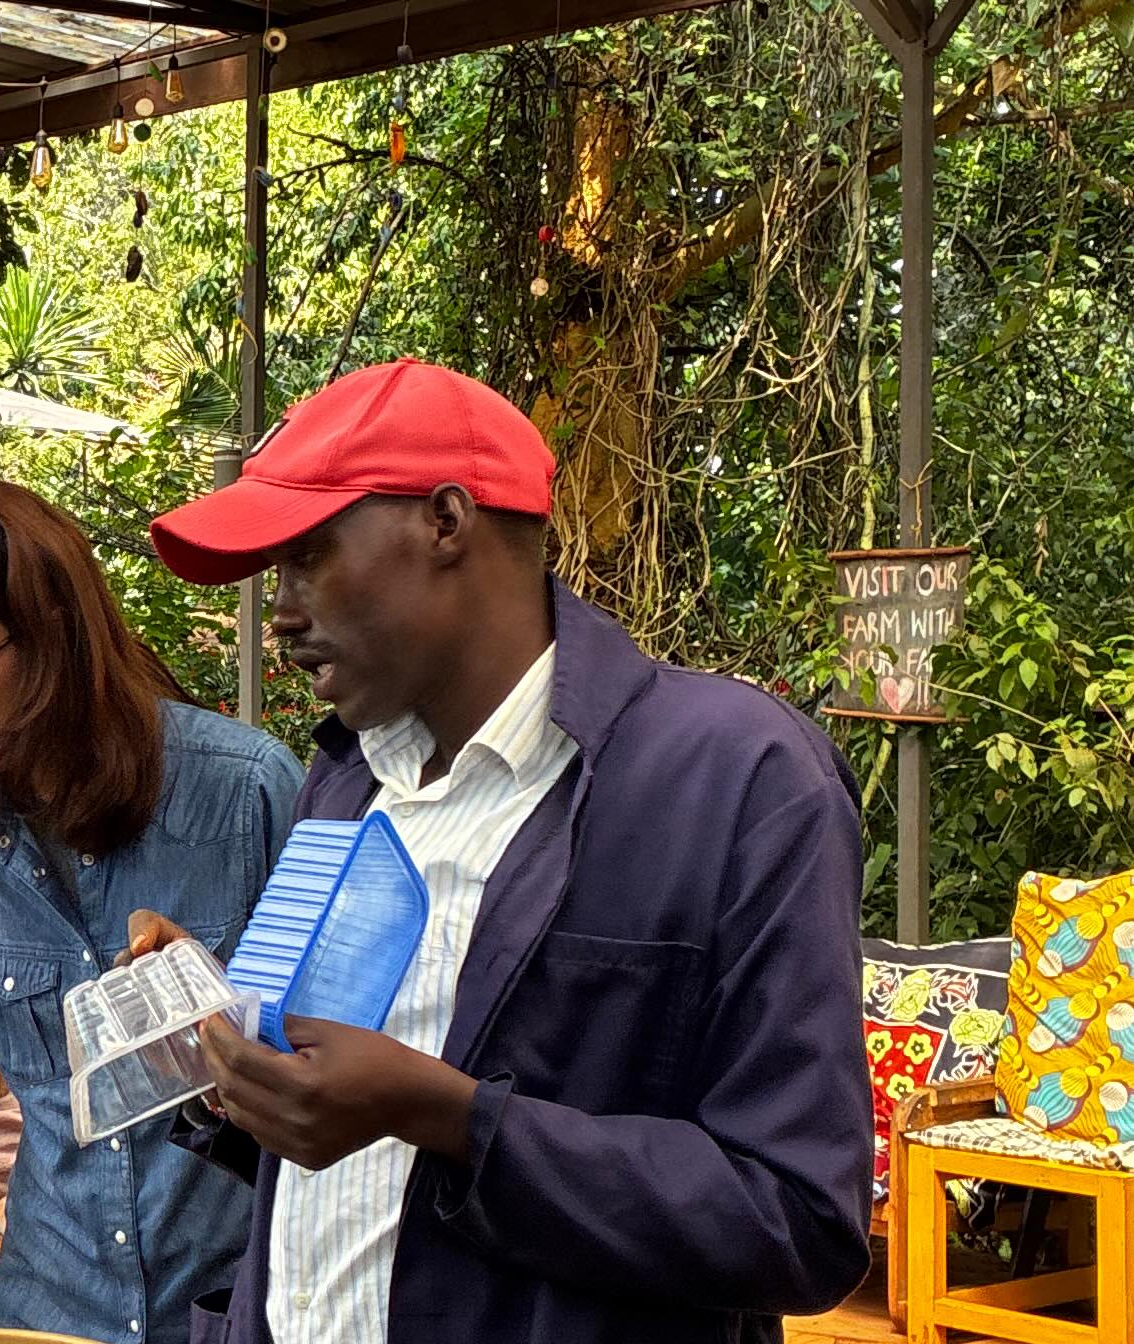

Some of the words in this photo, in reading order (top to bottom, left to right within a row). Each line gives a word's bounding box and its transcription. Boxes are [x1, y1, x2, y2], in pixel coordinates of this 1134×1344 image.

[844, 565, 906, 598] VISIT
[916, 561, 958, 596] OUR
[843, 610, 901, 644] FARM
[911, 607, 956, 639] WITH
[840, 648, 895, 680] YOUR
